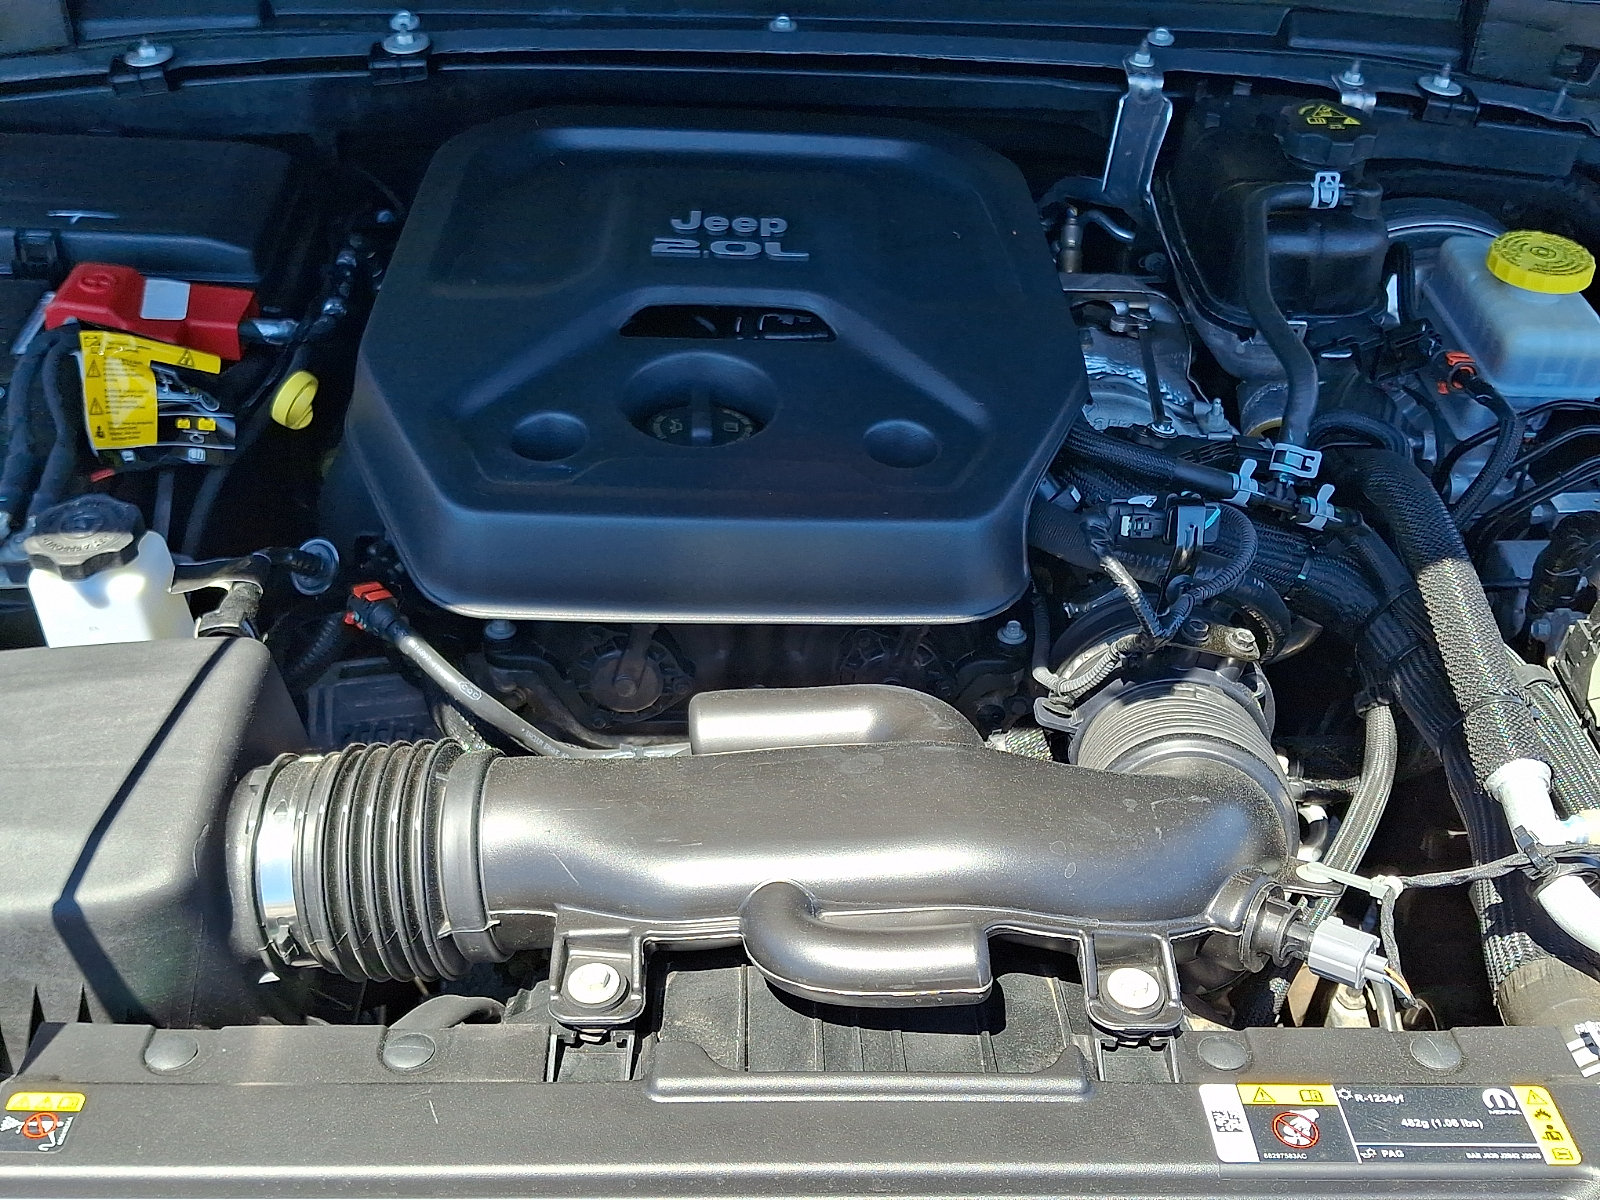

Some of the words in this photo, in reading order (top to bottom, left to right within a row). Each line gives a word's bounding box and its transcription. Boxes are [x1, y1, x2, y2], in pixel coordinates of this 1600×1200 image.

[670, 211, 788, 237] Jeep
[651, 238, 810, 261] 2.0L
[1354, 1093, 1405, 1104] R-1234yf
[1460, 1118, 1484, 1130] lbs)
[1381, 1149, 1405, 1158] PAG
